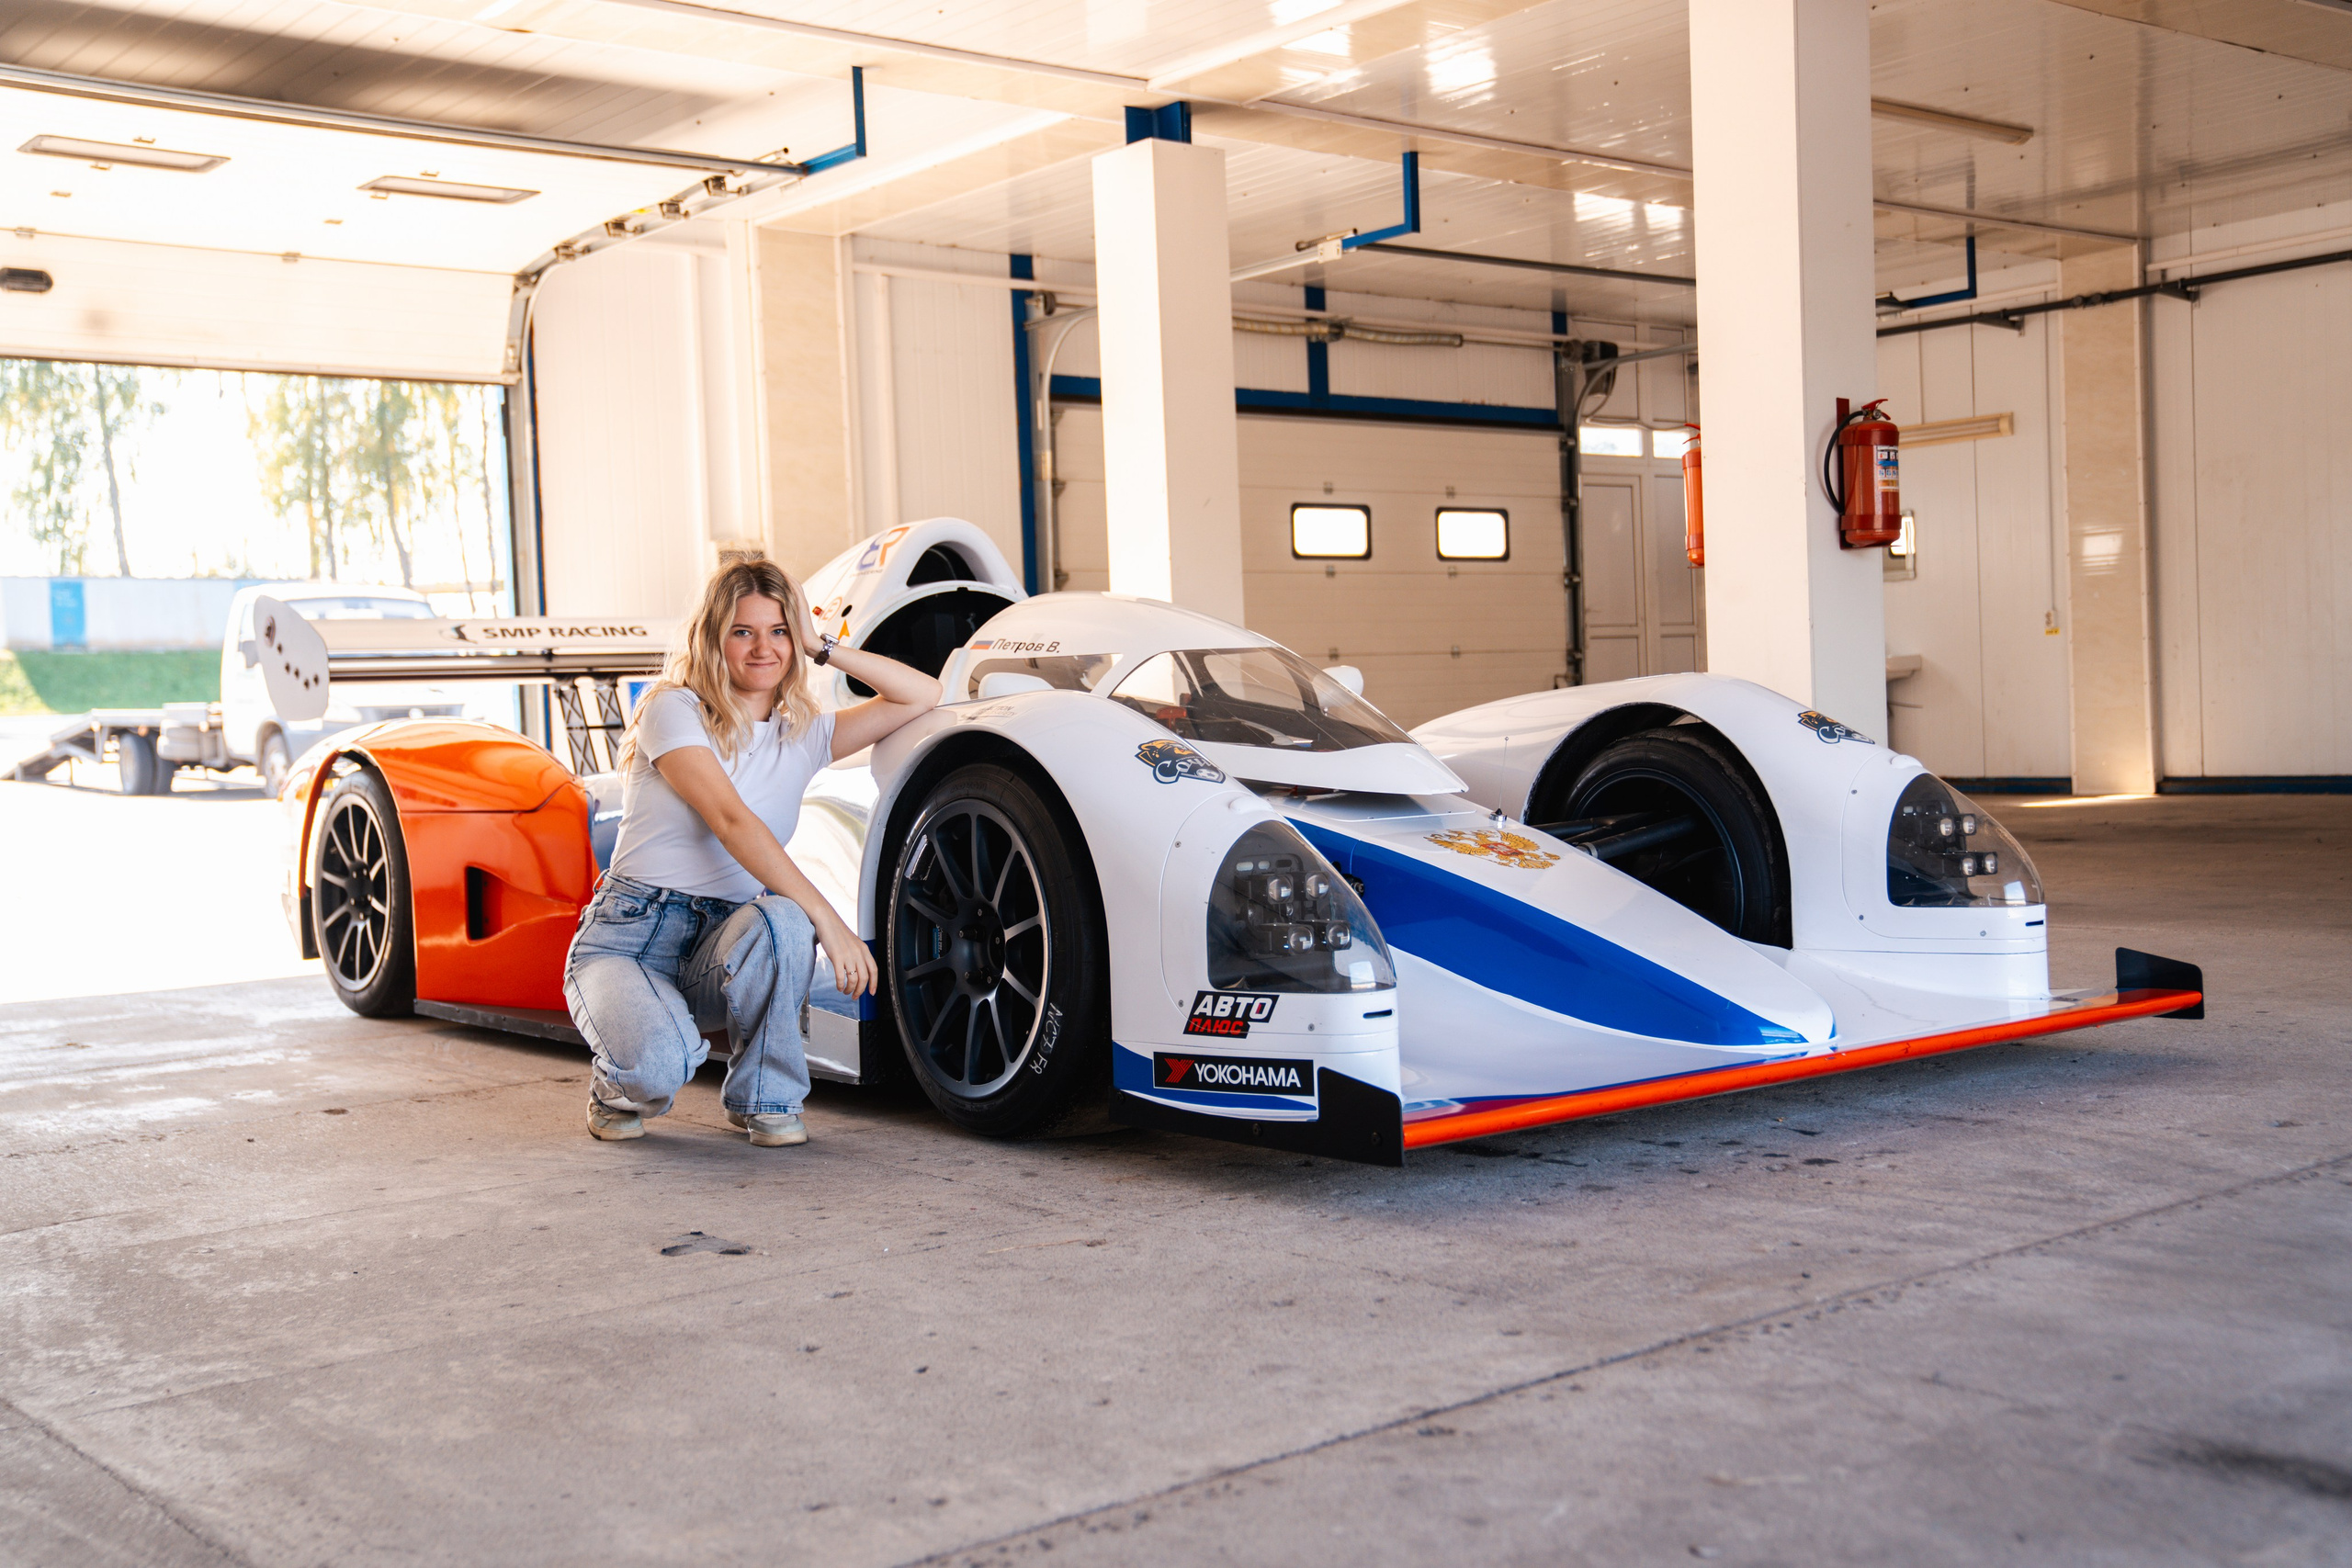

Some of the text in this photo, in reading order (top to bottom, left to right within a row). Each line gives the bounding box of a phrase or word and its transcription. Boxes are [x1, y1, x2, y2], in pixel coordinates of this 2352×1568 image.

[482, 626, 649, 638] SMP RACING
[992, 638, 1045, 653] Петров
[1193, 994, 1273, 1020] АВТО
[1188, 1018, 1244, 1035] ПЛЮС
[1194, 1063, 1301, 1088] YOKOHAMA
